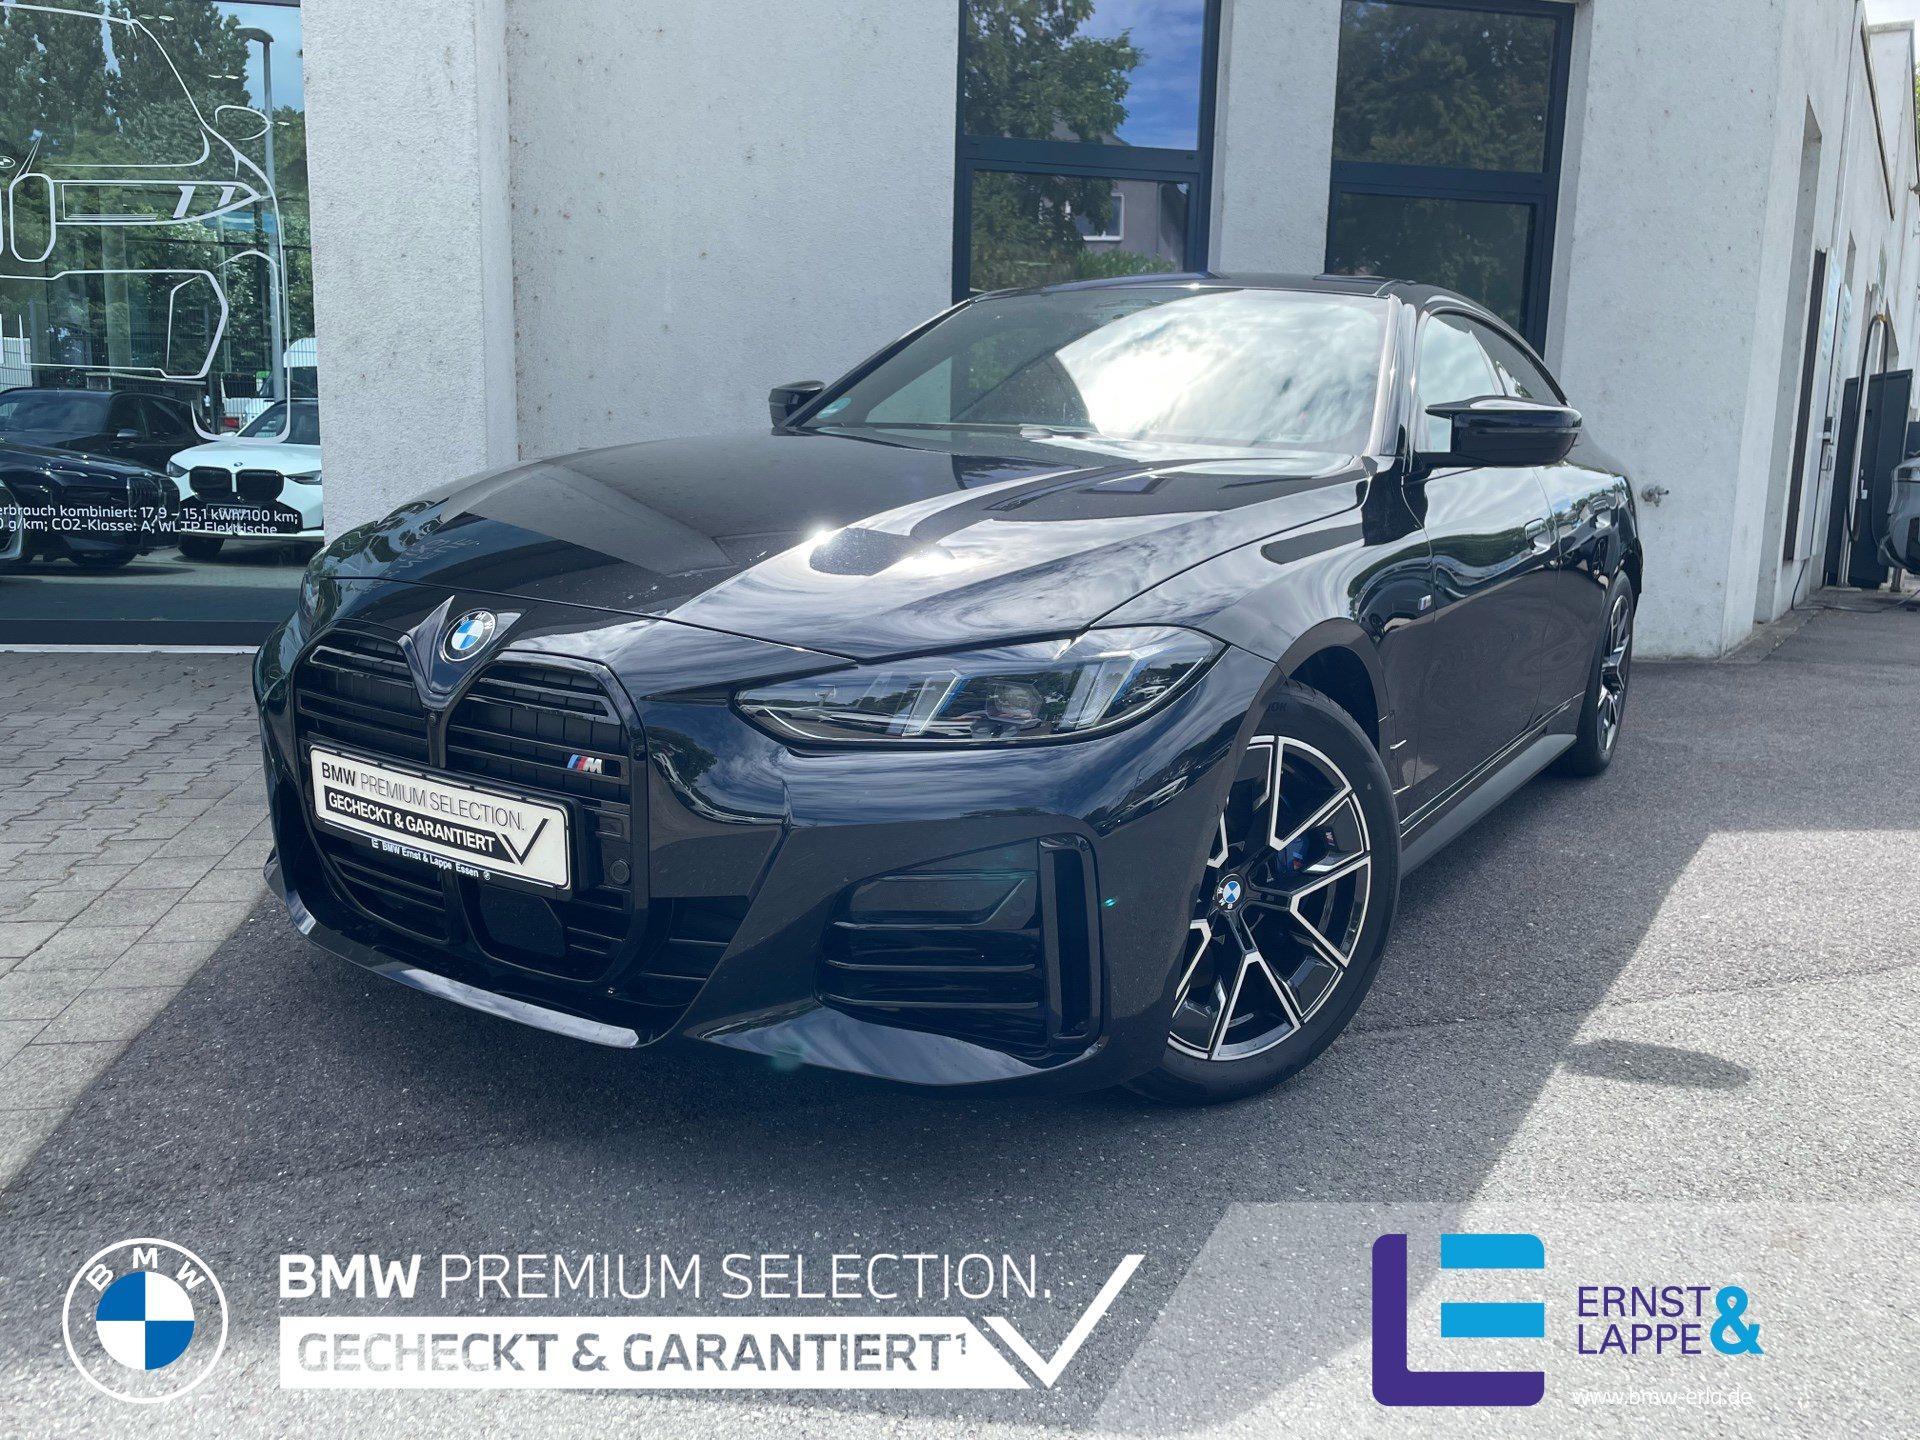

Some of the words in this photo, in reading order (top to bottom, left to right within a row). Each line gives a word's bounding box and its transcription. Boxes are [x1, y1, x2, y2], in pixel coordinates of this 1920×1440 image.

[8, 518, 48, 532] g/km;
[52, 518, 137, 532] CO2-Klasse:
[158, 520, 200, 532] WLTP
[204, 522, 277, 534] Elektrische
[60, 505, 137, 518] kombiniert:
[140, 506, 167, 520] 17,9
[183, 507, 207, 521] 15,1
[211, 508, 270, 522] kWh/100
[274, 510, 298, 525] km;
[322, 762, 356, 787] BMW
[360, 773, 428, 808] PREMIUM
[429, 791, 525, 831] SELECTION.
[328, 792, 392, 825] GECHECKT
[394, 812, 404, 829] &
[405, 815, 496, 852] GARANTIERT
[382, 841, 400, 855] BMW
[402, 847, 421, 861] Ernst
[430, 855, 452, 870] Lappe
[455, 862, 479, 878] Essen
